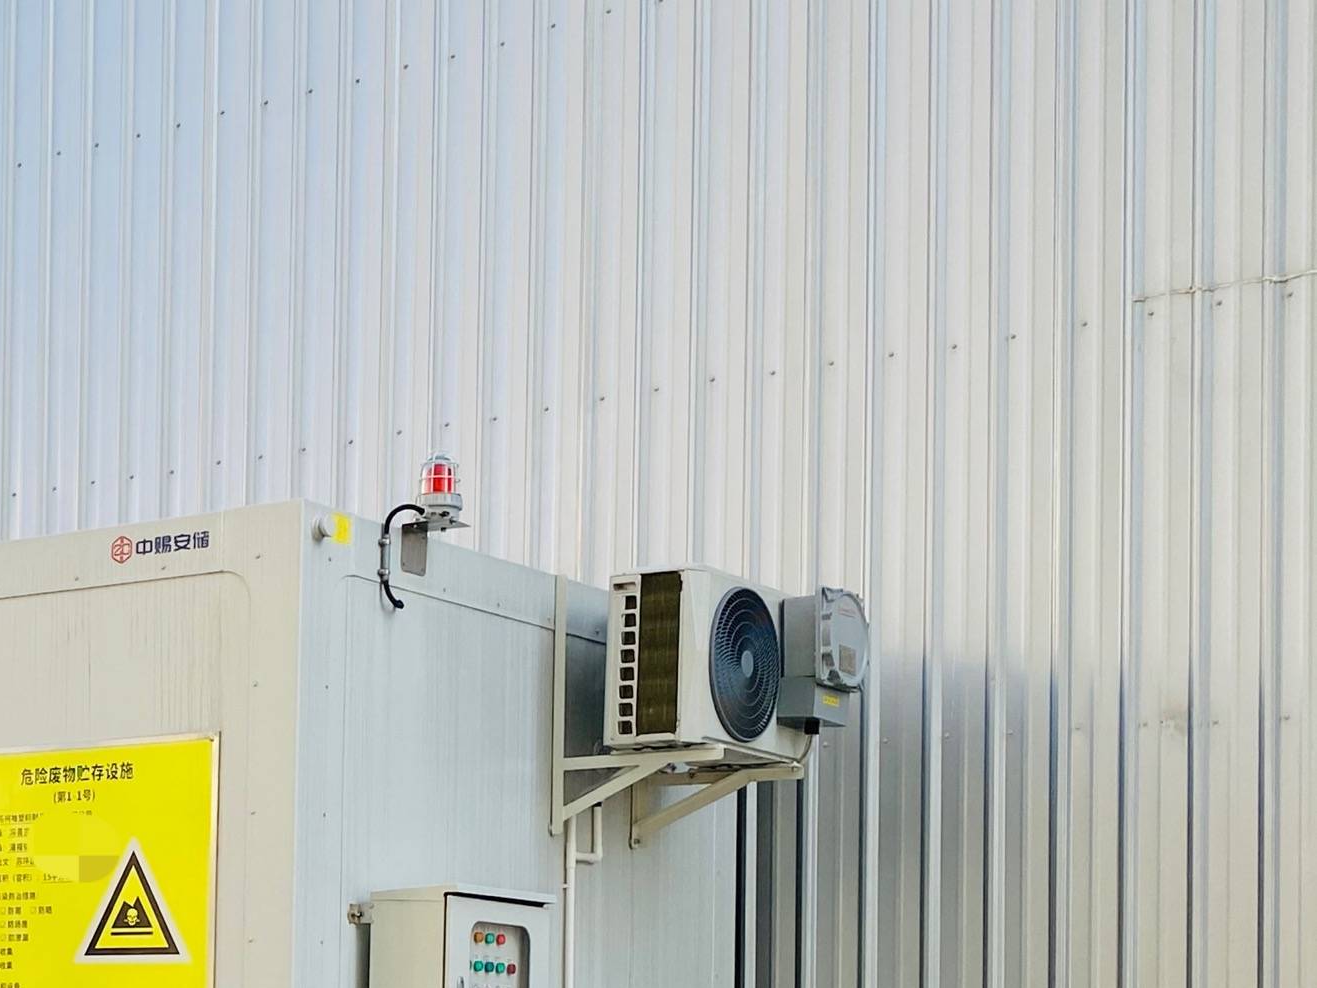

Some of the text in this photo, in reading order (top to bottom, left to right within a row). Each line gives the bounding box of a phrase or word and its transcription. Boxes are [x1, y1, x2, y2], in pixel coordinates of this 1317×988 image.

[135, 531, 209, 555] 中赐安储
[20, 761, 134, 786] 危险废物贮存设施
